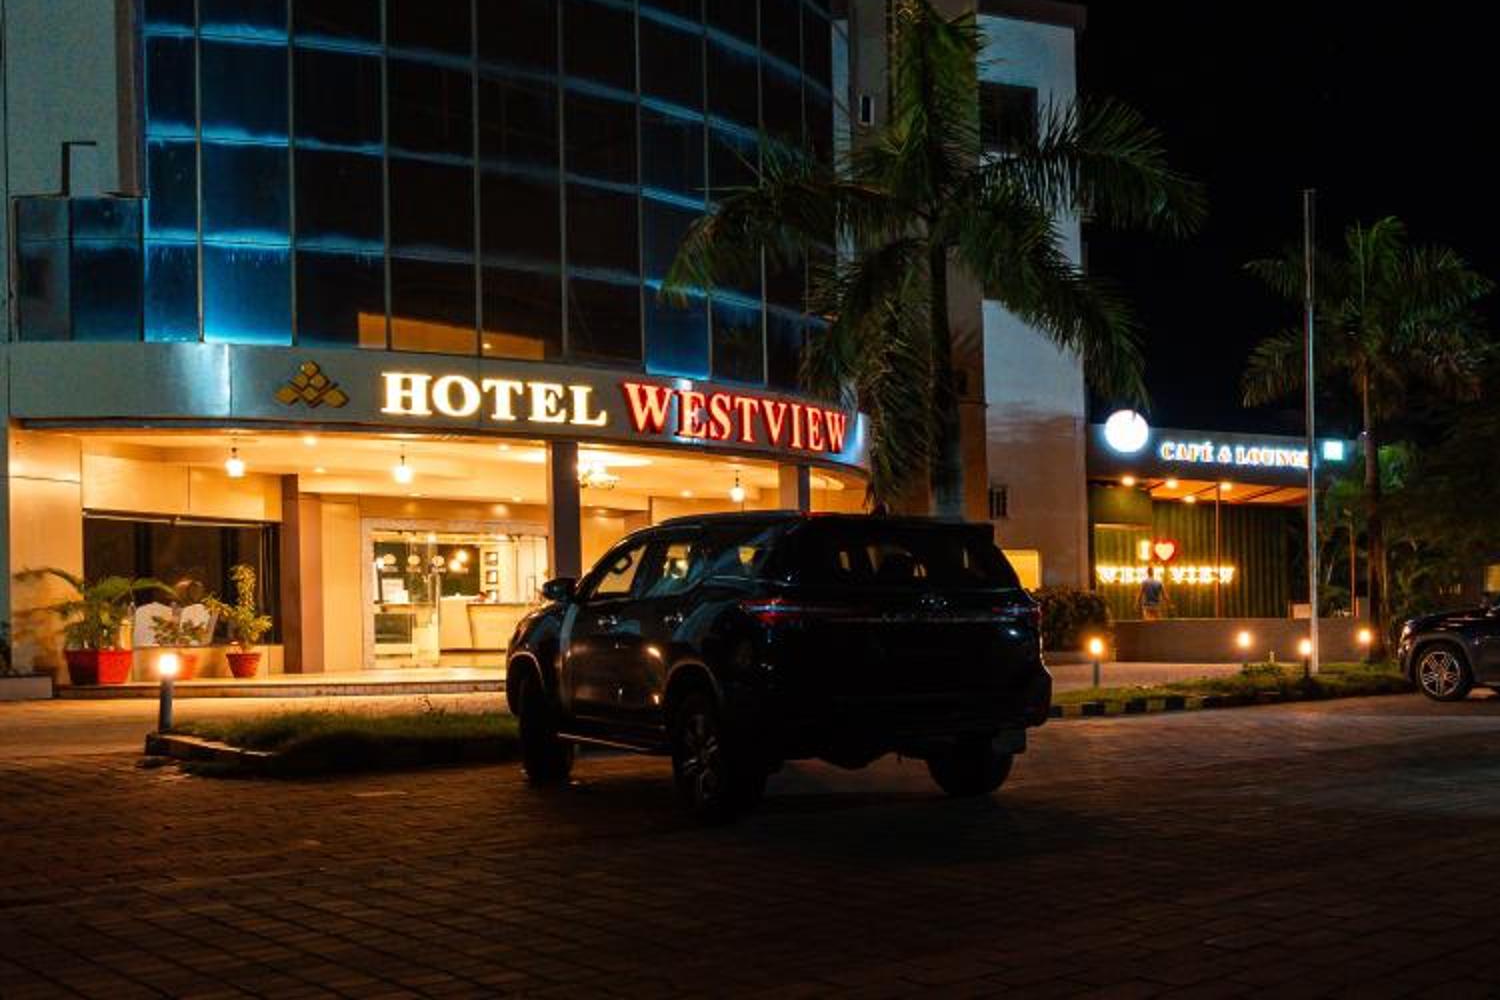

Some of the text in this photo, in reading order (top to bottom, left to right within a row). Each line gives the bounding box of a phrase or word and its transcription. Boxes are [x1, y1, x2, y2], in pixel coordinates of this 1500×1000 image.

[381, 372, 846, 453] HOTEL WESTVIEW
[1218, 445, 1231, 464] &
